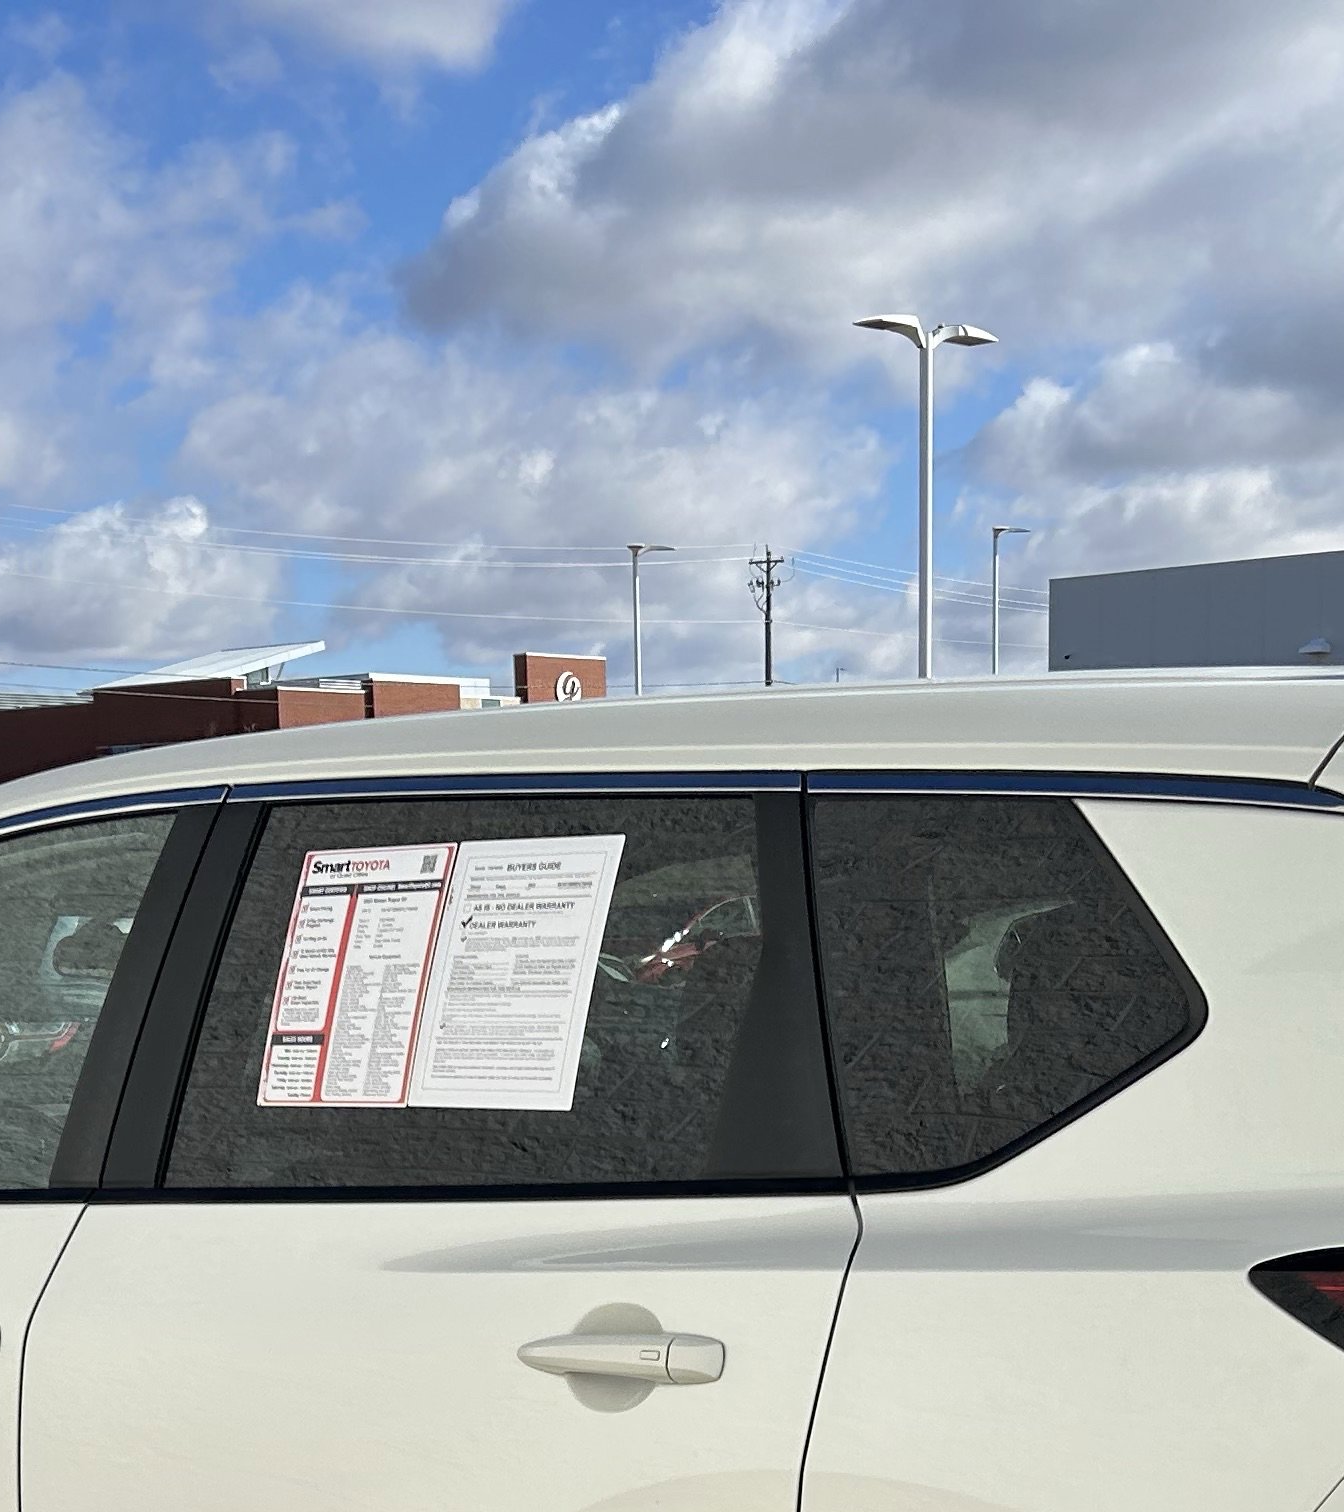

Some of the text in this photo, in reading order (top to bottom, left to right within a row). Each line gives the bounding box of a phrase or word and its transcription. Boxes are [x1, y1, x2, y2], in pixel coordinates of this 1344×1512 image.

[312, 859, 391, 875] Smart TOYOTA
[507, 863, 536, 872] BUYERS
[539, 862, 561, 871] GUIDE
[507, 903, 534, 911] DEALER
[536, 901, 575, 910] WARRANTY
[469, 920, 536, 930] DEALER WARRANTY
